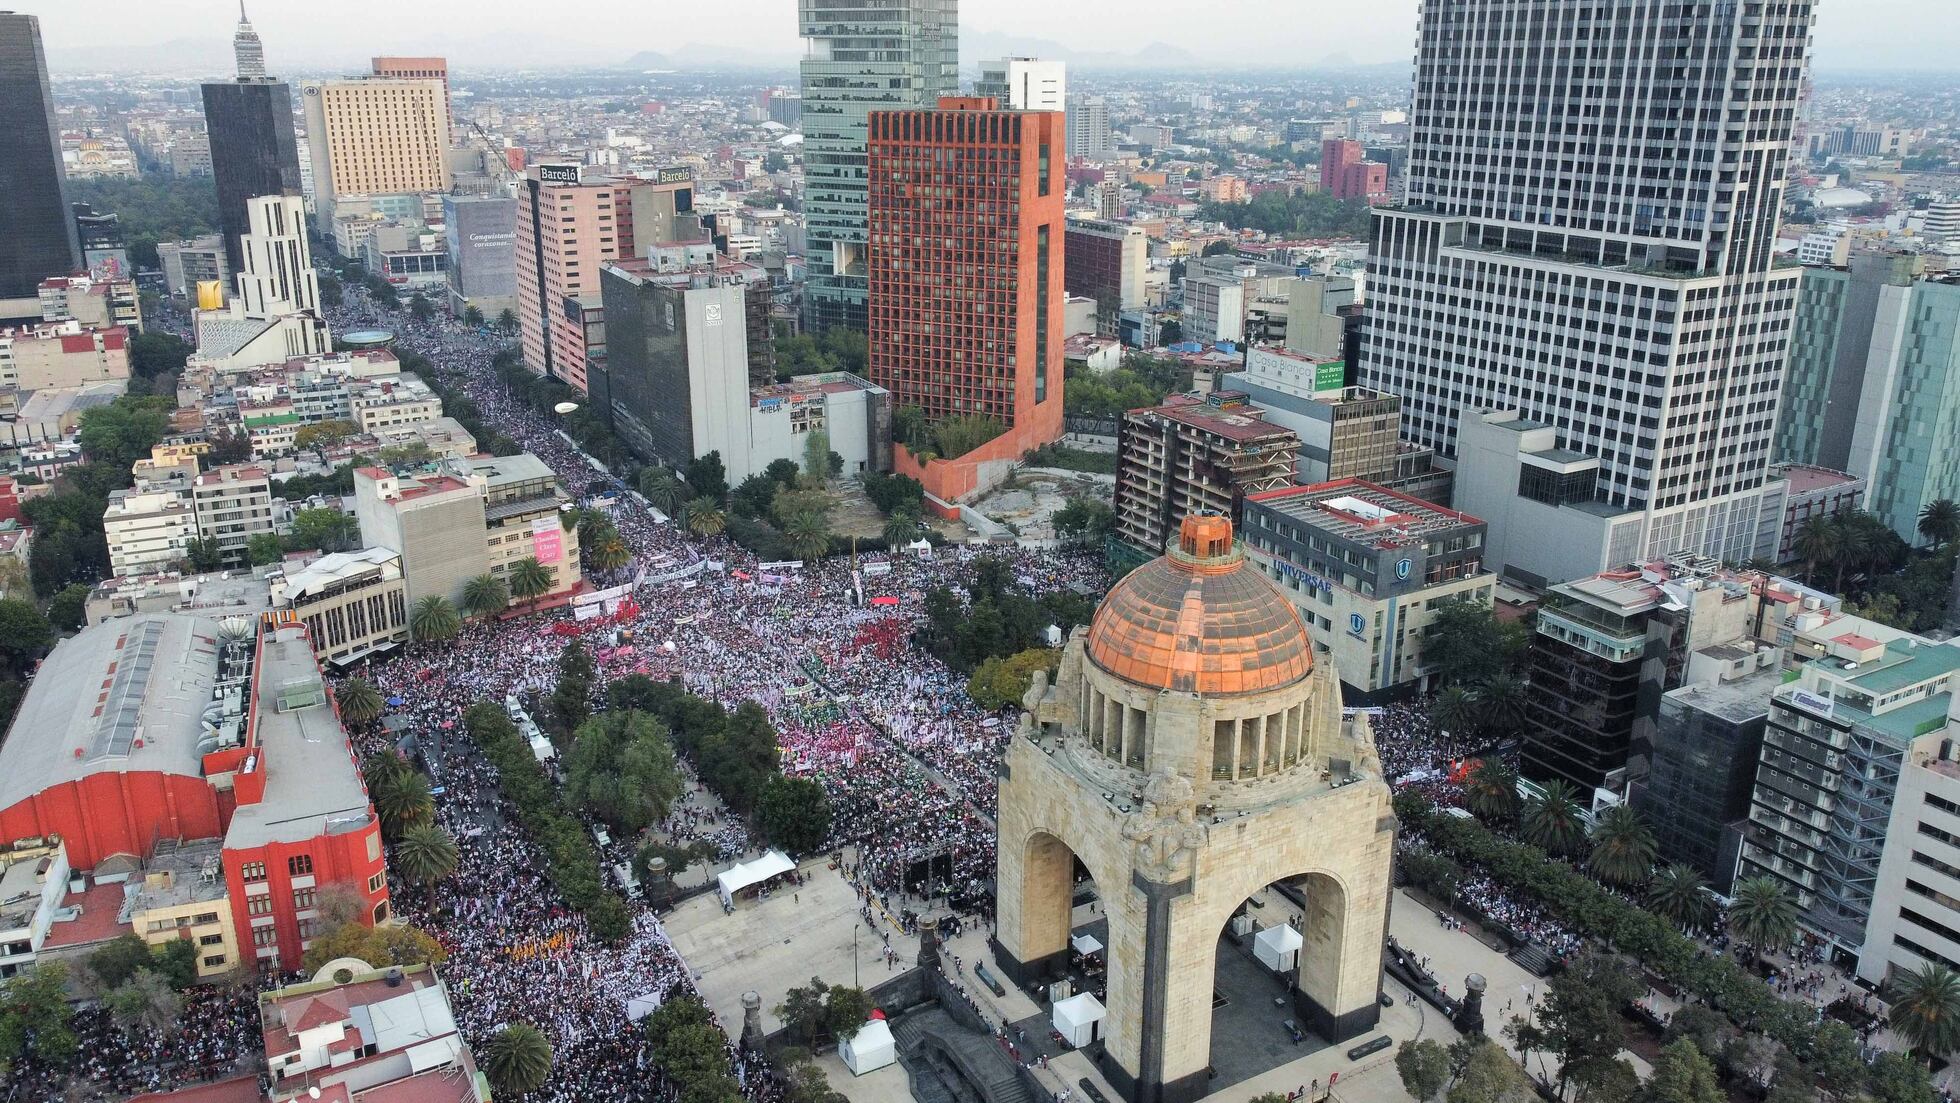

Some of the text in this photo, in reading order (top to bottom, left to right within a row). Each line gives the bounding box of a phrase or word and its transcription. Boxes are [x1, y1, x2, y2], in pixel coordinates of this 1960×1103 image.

[541, 168, 576, 181] Barceló
[661, 170, 690, 182] Barceló
[470, 231, 517, 241] Conquistando
[1255, 353, 1311, 377] Casa Blanca
[1274, 560, 1332, 592] UNIVERSAE
